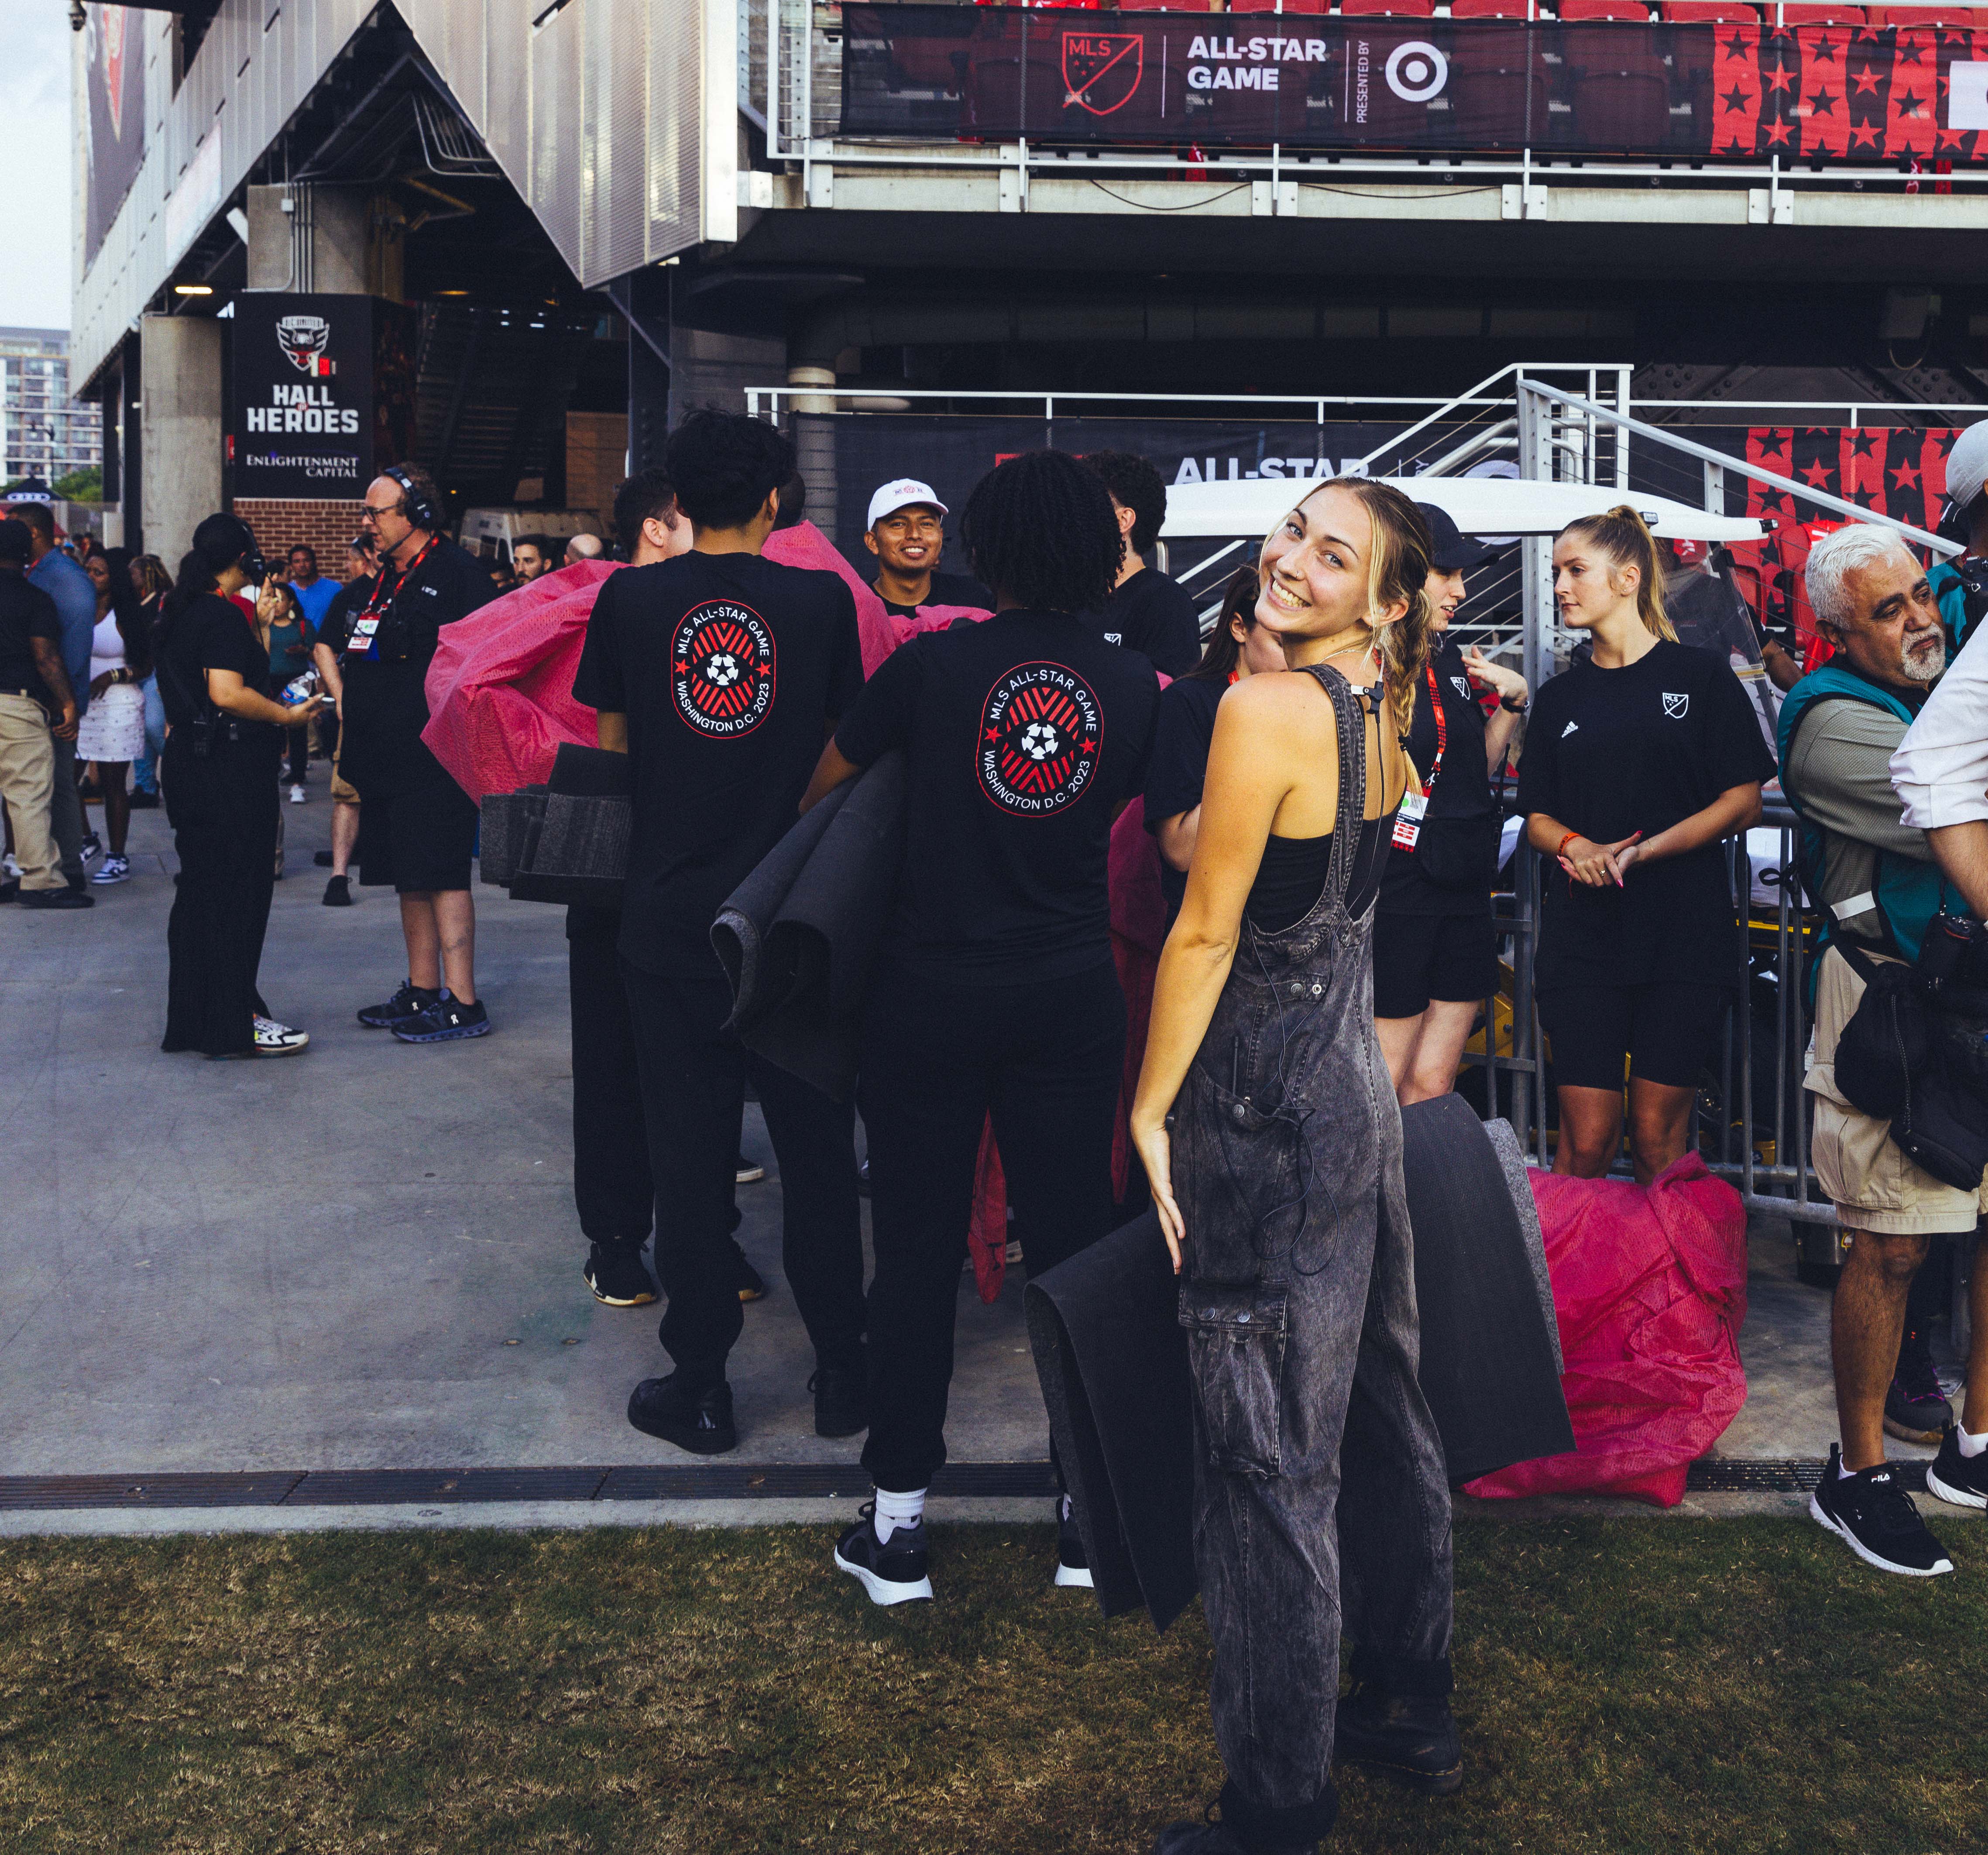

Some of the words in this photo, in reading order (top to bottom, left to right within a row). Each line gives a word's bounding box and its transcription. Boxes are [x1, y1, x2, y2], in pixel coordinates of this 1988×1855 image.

[1069, 39, 1111, 56] MLS
[1187, 36, 1326, 62] ALL-STAR
[1358, 40, 1369, 55] BY
[1187, 66, 1279, 91] GAME
[1356, 57, 1369, 123] PRESENTED
[273, 384, 335, 407] HALL
[247, 407, 359, 433] HEROES
[246, 454, 357, 467] ENLIGHTENMENT
[306, 468, 358, 478] CAPITAL
[678, 627, 693, 654] MLS
[693, 607, 747, 627] ALL-STAR
[749, 621, 769, 656] GAME
[677, 681, 733, 731] WASHINGTON
[735, 713, 757, 729] D.C.
[753, 683, 769, 713] 2023
[990, 690, 1009, 720] MLS
[1009, 669, 1075, 691] ALL-STAR
[1075, 690, 1096, 732] GAME
[984, 750, 1040, 809] WASHINGTON
[1044, 792, 1069, 809] D.C.
[1068, 761, 1090, 793] 2023
[1871, 1473, 1890, 1483] FILA
